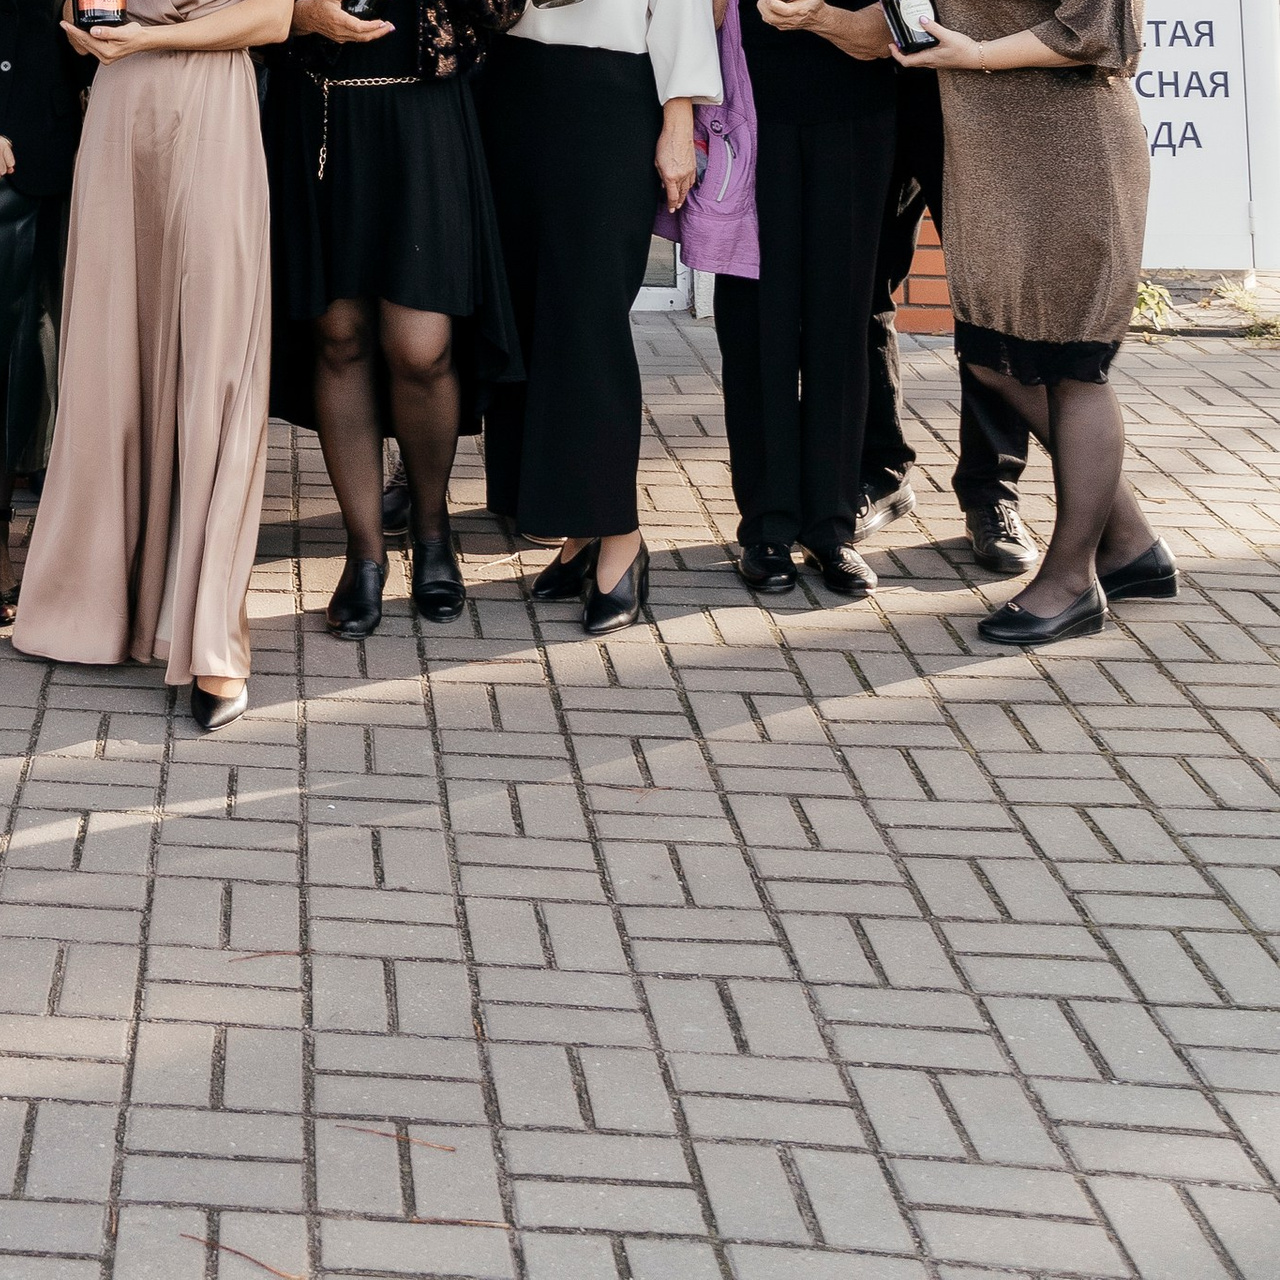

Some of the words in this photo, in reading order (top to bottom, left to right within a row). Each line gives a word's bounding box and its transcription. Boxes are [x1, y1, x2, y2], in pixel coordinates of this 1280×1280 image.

[1143, 20, 1215, 47] ТАЯ
[1135, 70, 1230, 98] СНАЯ
[1143, 121, 1203, 157] ДА
